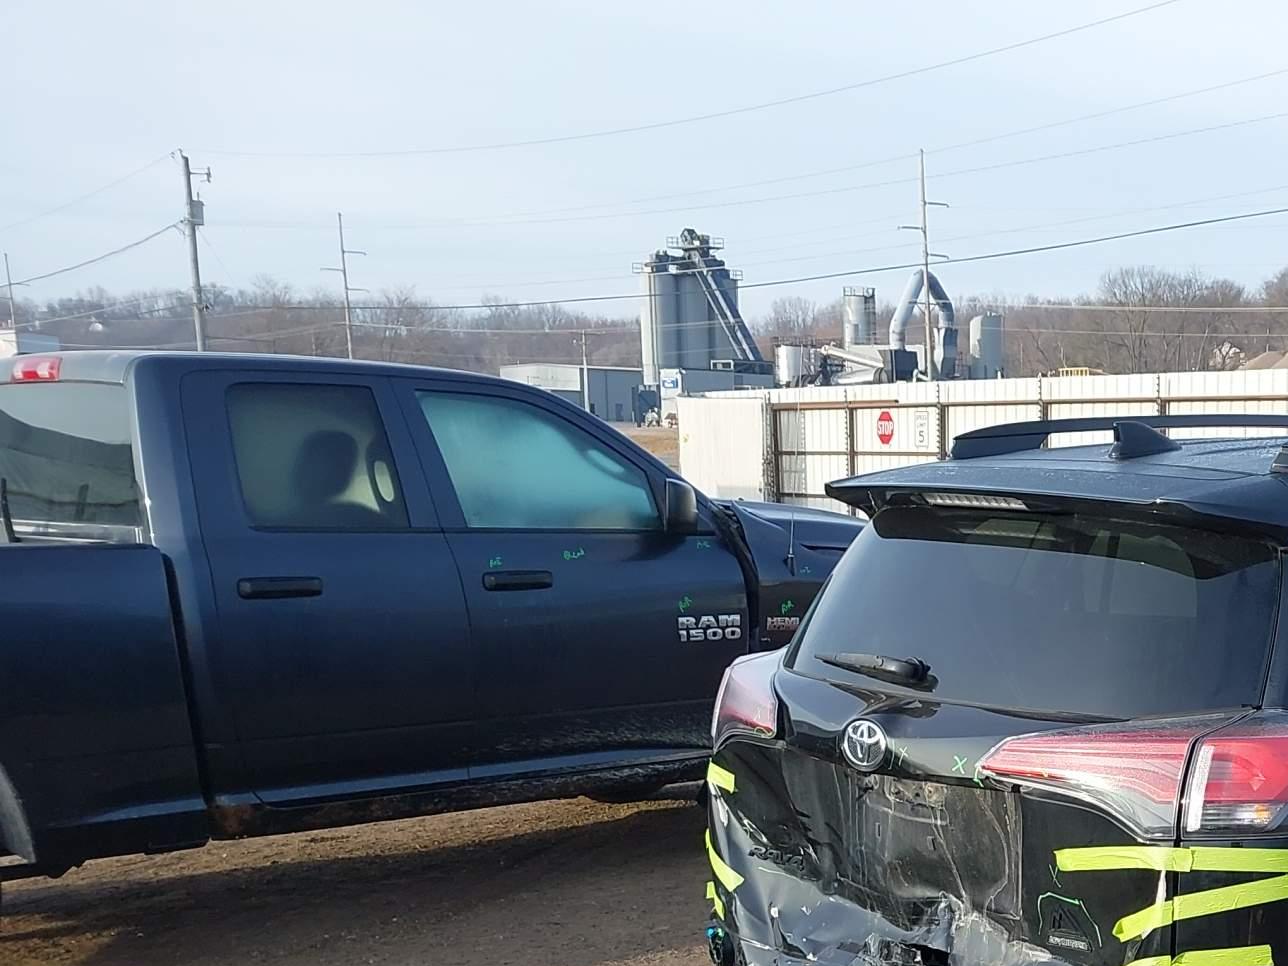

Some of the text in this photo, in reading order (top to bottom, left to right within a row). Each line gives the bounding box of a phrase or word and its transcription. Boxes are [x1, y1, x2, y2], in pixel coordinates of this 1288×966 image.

[877, 420, 894, 435] STOP
[918, 430, 925, 443] 5
[677, 614, 741, 629] RAM
[766, 616, 800, 626] HEMI
[678, 627, 742, 642] 1500
